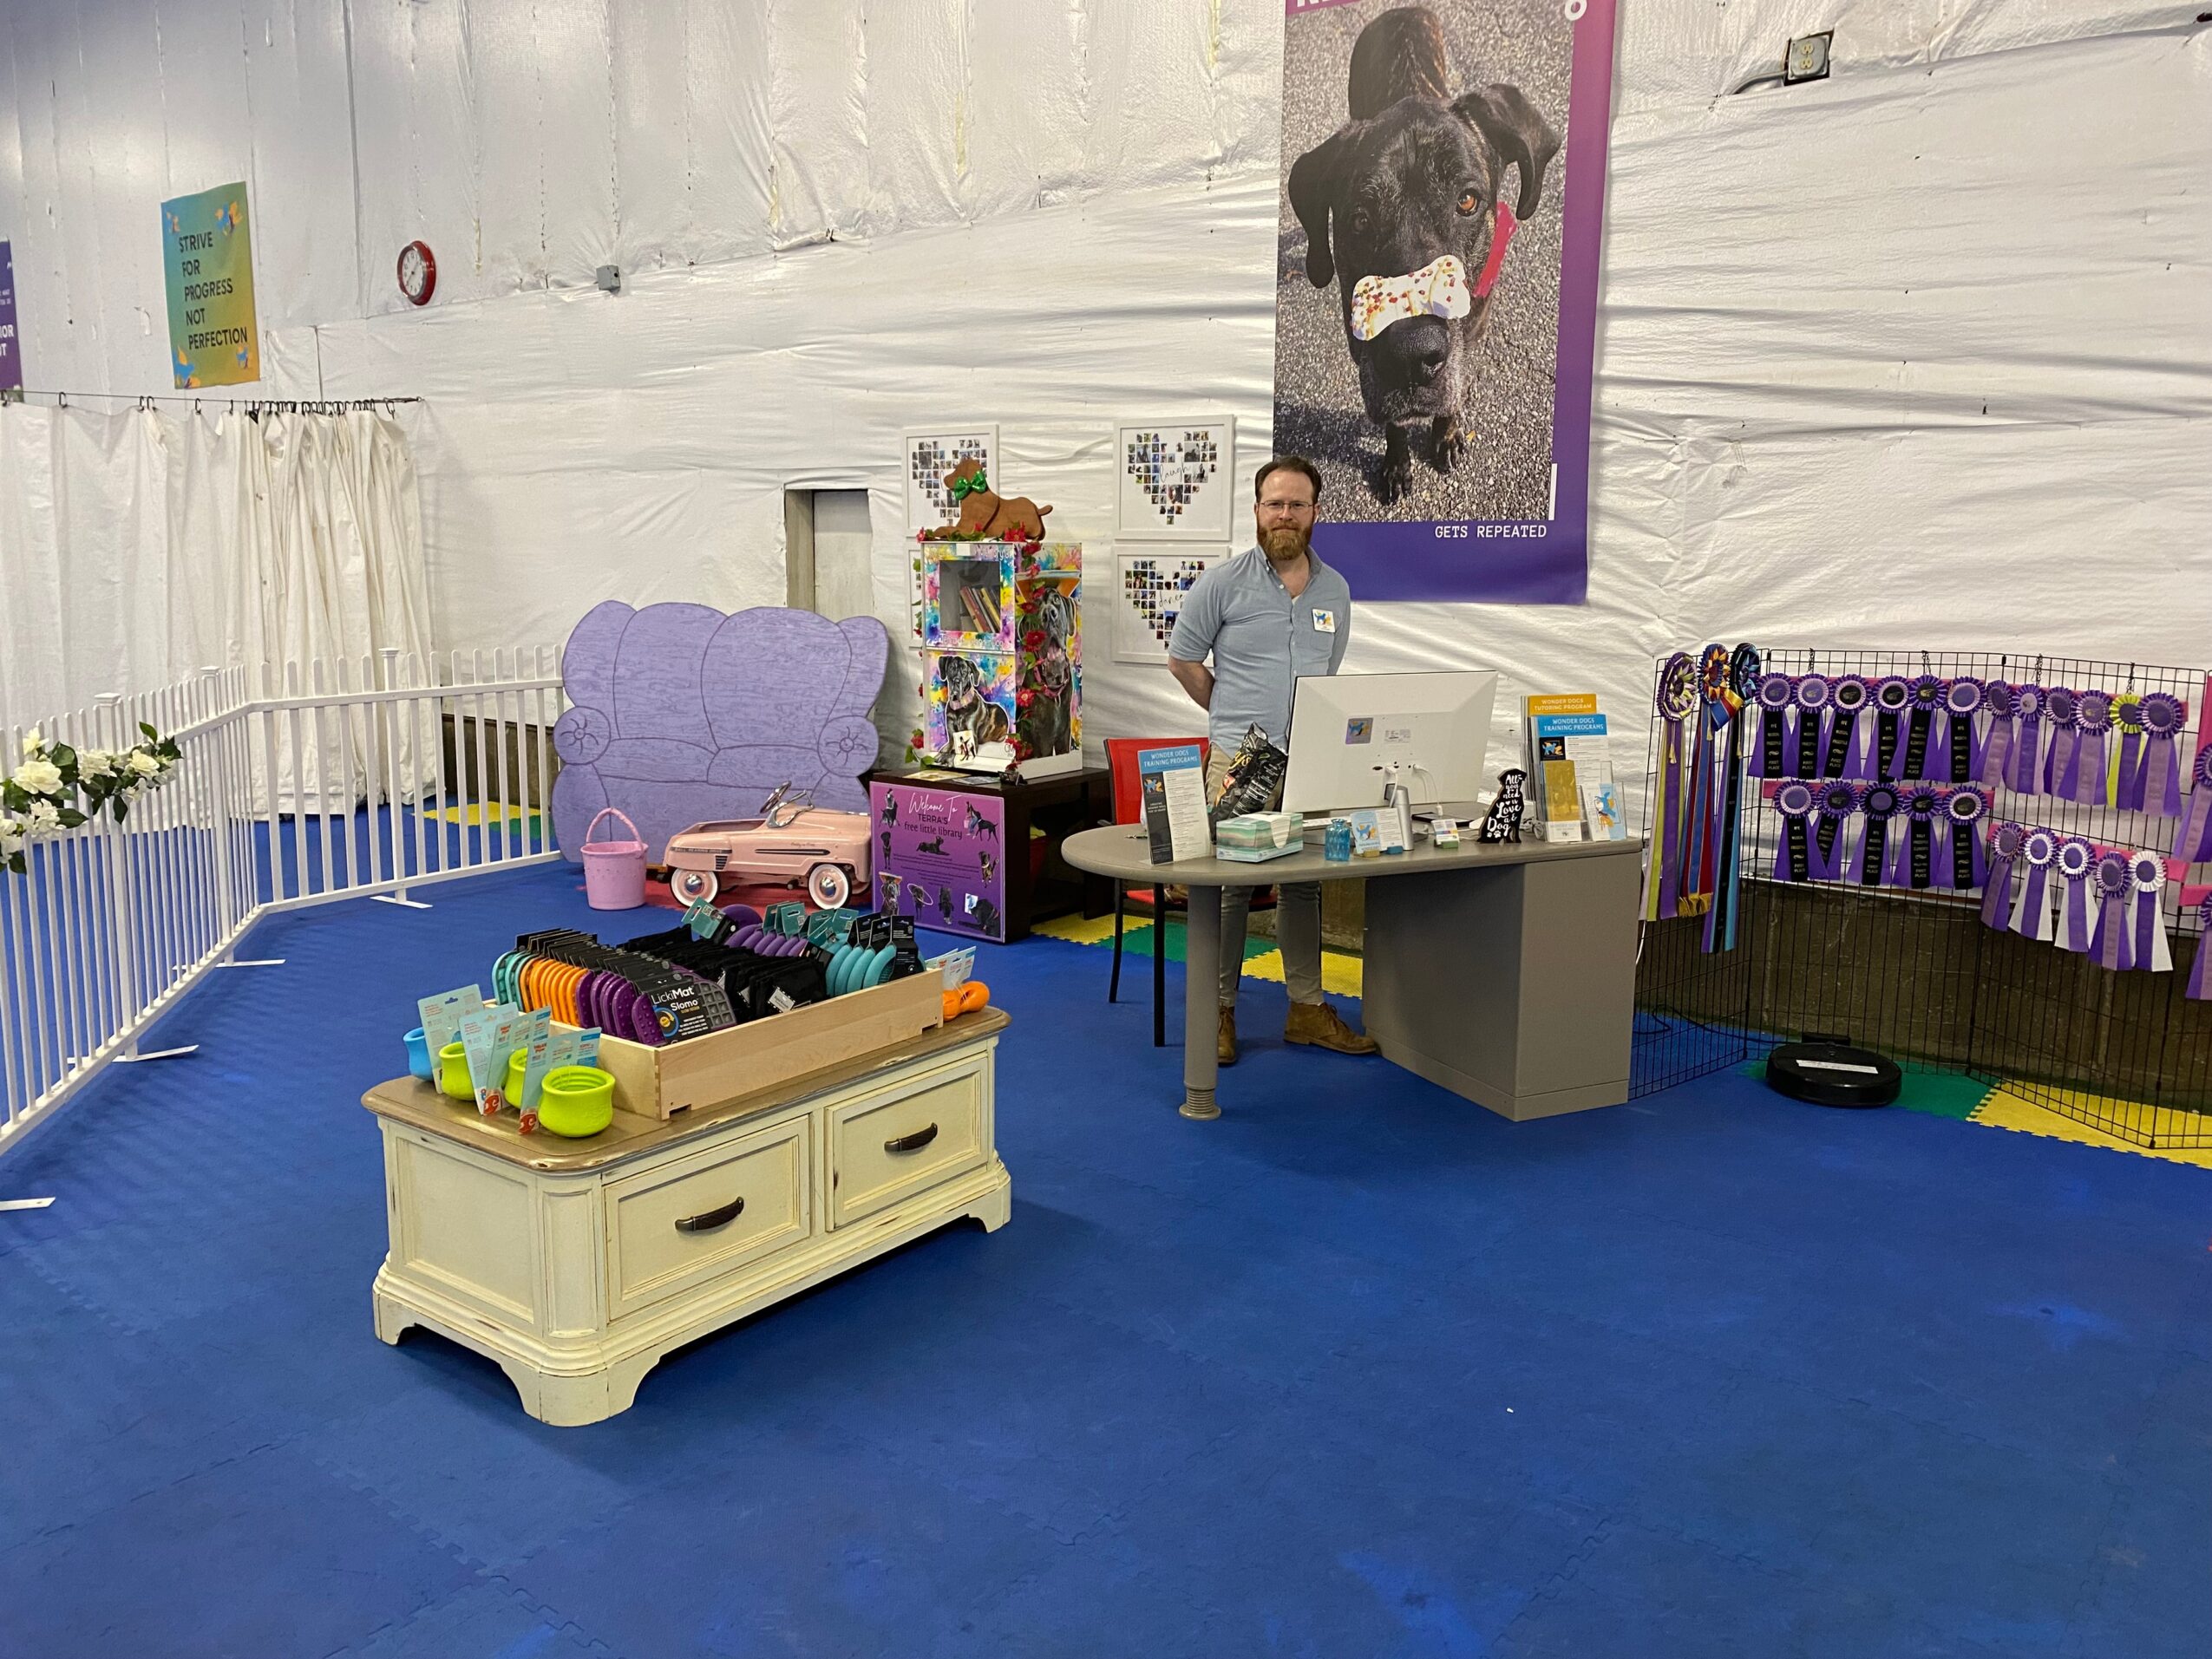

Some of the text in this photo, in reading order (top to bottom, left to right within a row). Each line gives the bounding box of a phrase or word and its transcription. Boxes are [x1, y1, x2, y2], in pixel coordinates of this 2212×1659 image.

[179, 232, 213, 253] STRIVE
[181, 259, 200, 278] FOR
[184, 278, 233, 302] PROGRESS
[186, 308, 206, 326] NOT
[188, 326, 248, 349] PERFECTION
[1435, 525, 1547, 539] GETS REPEATED
[1144, 759, 1169, 767] TRAINING
[1170, 755, 1197, 764] PROGRAMS
[1151, 751, 1174, 760] WONDER
[1506, 774, 1520, 784] All
[1503, 788, 1520, 799] need
[1505, 784, 1519, 794] you
[908, 793, 962, 821] Welcome To
[1496, 801, 1521, 818] Love
[919, 813, 948, 825] TERRA'S
[1487, 816, 1511, 837] Dog
[904, 821, 962, 839] free little library
[651, 986, 695, 1004] LickiMat
[671, 999, 698, 1011] Slomo
